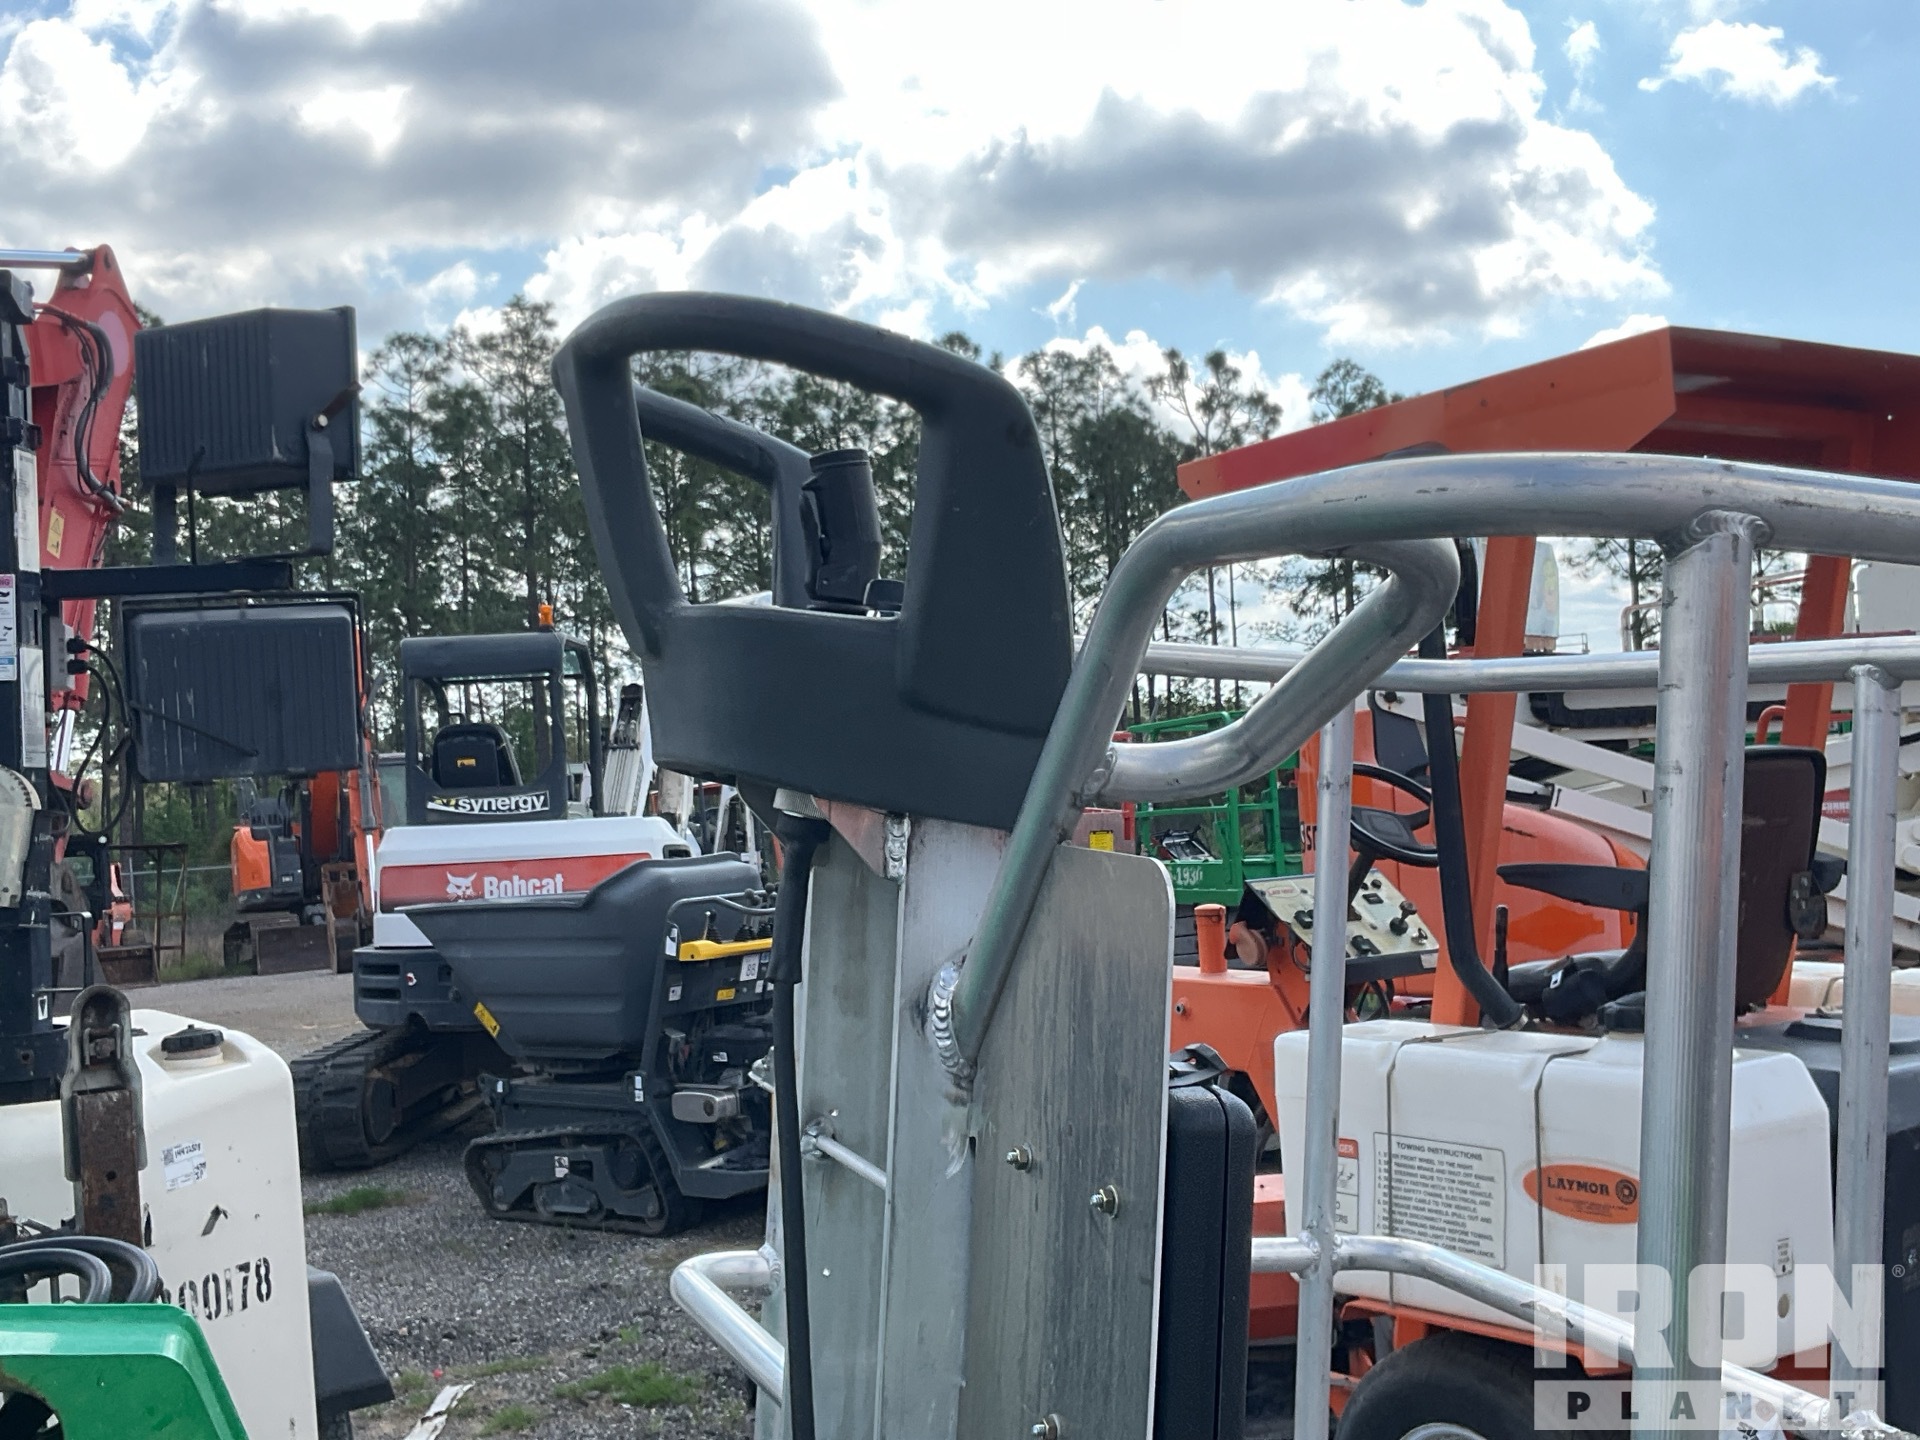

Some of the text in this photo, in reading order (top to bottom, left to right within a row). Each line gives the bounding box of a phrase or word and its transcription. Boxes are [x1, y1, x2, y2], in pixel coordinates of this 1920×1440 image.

[458, 795, 545, 814] synergy
[484, 873, 564, 899] Bobcat
[1396, 1142, 1482, 1161] TOWING INSTRUCTIONS
[1547, 1177, 1610, 1196] LAYMOR
